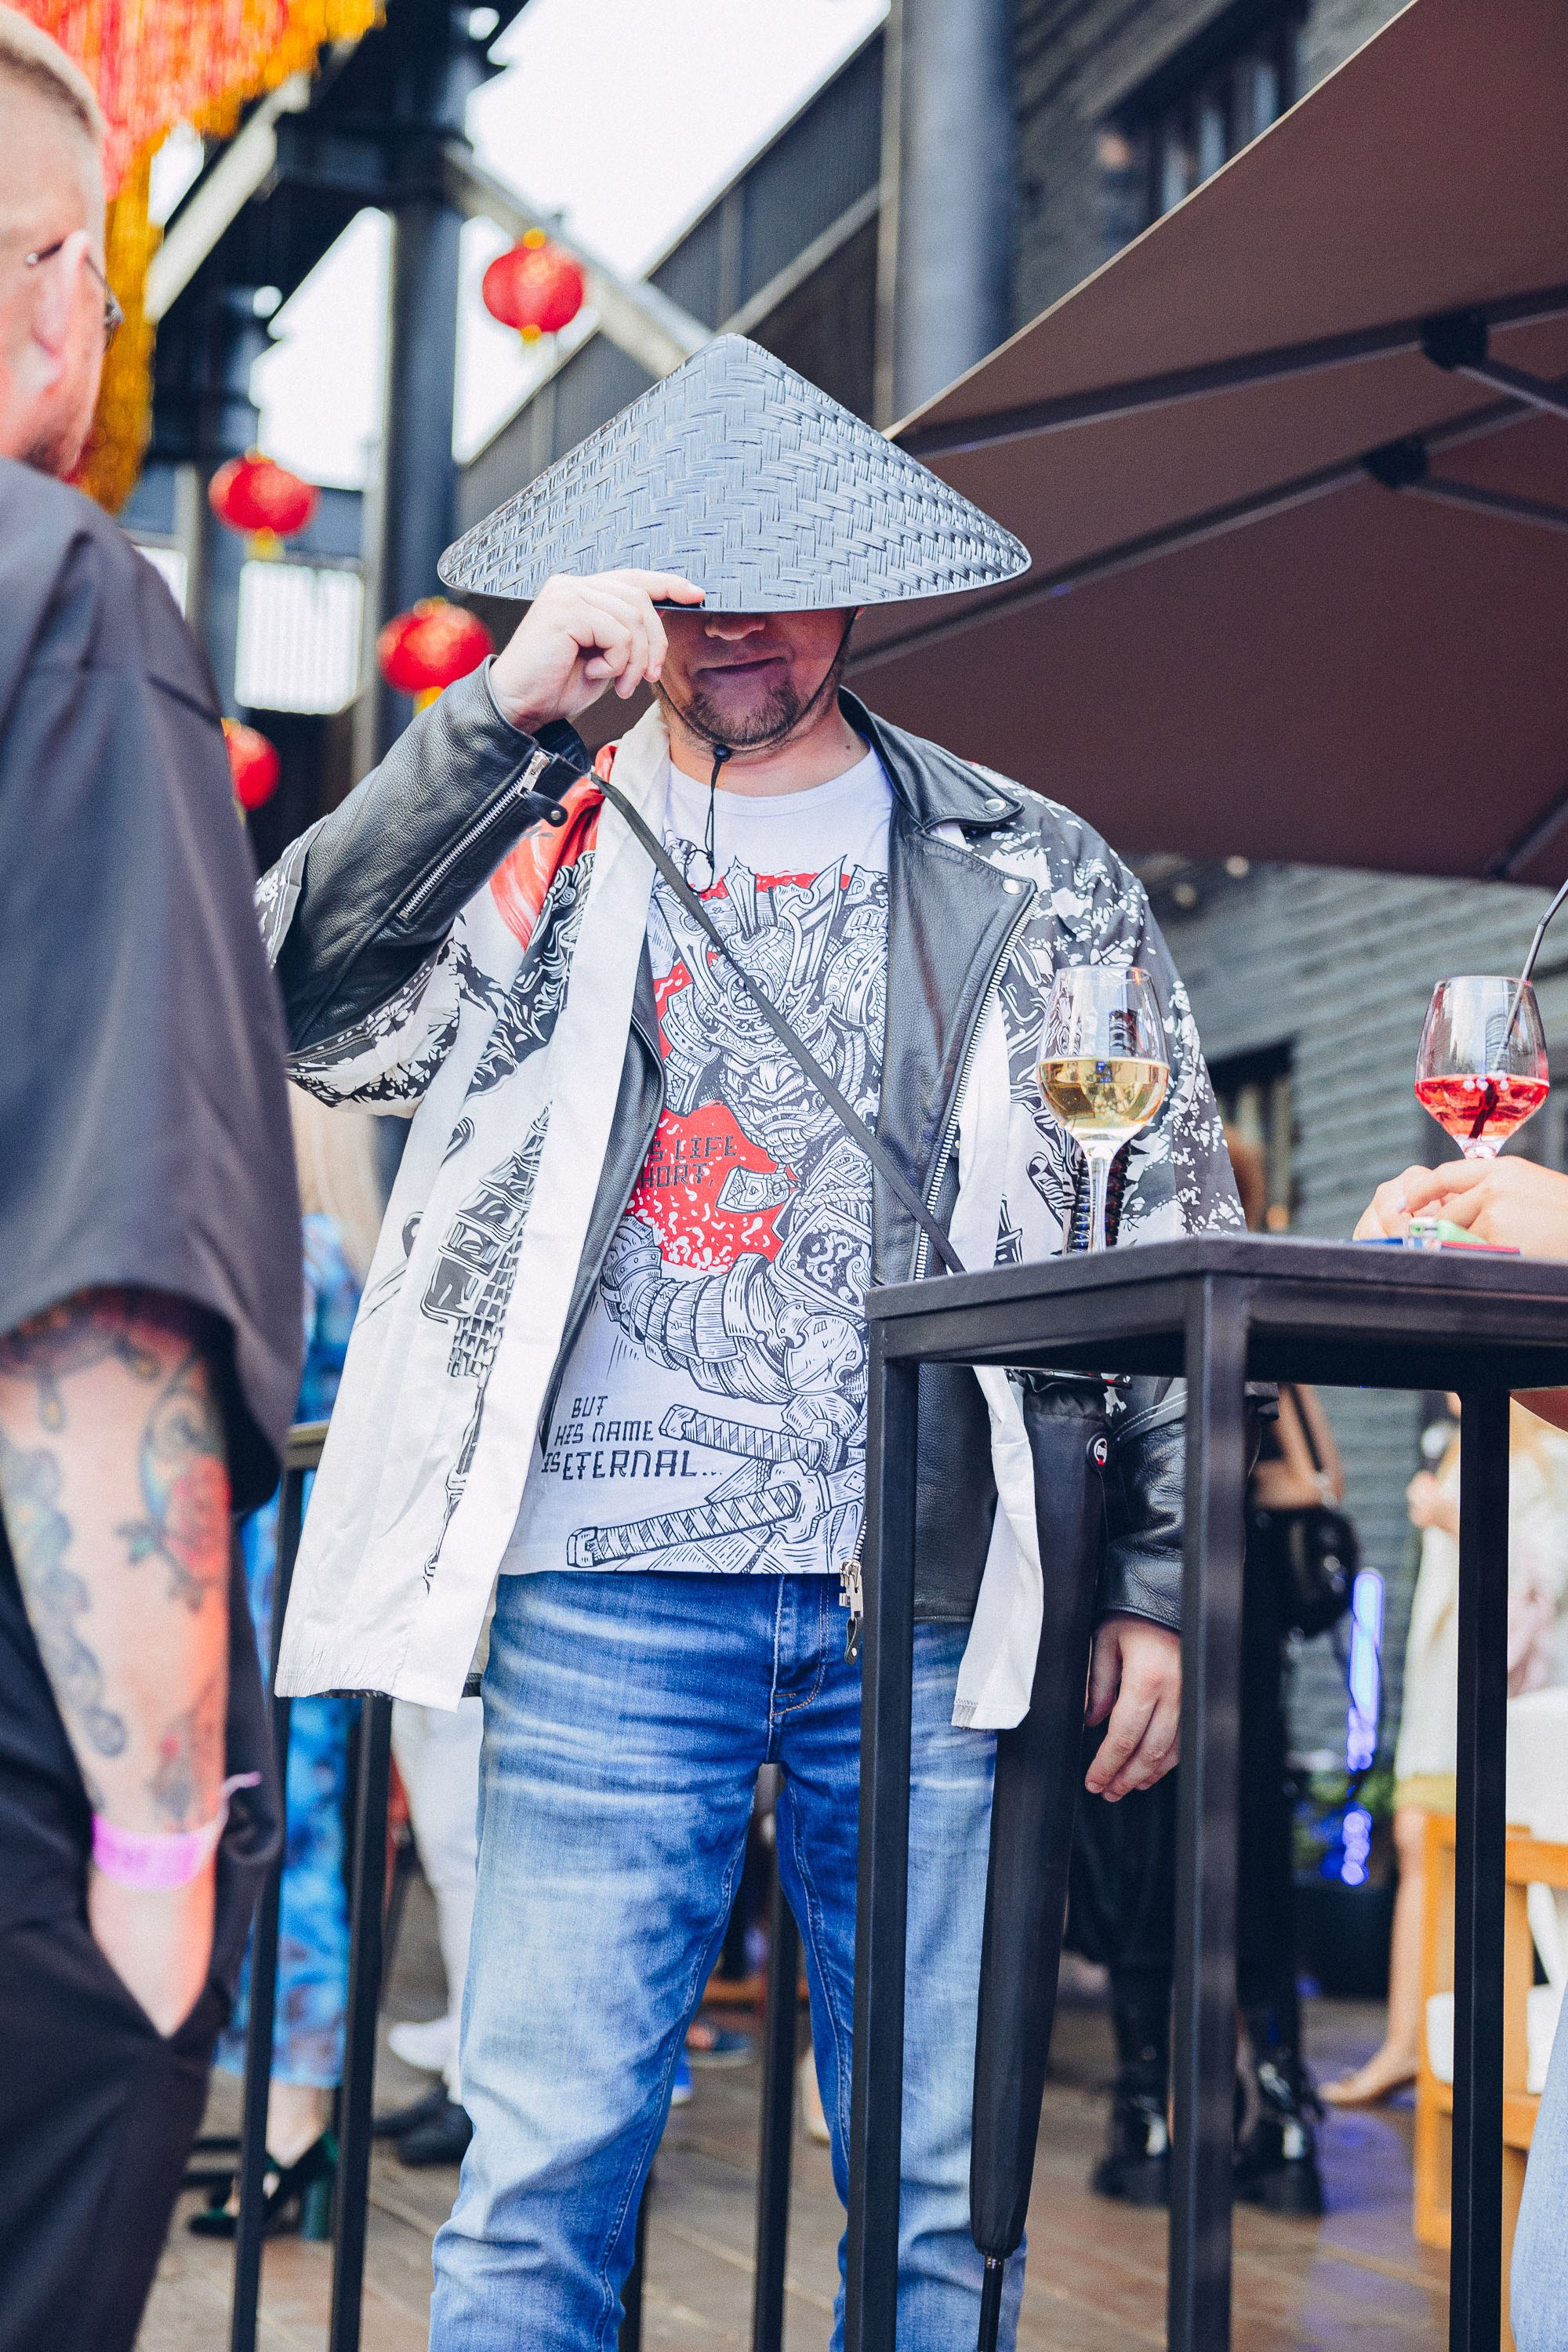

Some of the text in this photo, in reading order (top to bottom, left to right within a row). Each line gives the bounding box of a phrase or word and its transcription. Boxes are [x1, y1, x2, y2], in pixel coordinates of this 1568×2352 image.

[675, 1135, 737, 1160] LIFE
[640, 1163, 713, 1189] HORT,
[571, 1396, 608, 1418] BUT
[554, 1420, 654, 1446] HIS NAME
[541, 1451, 561, 1473] IS
